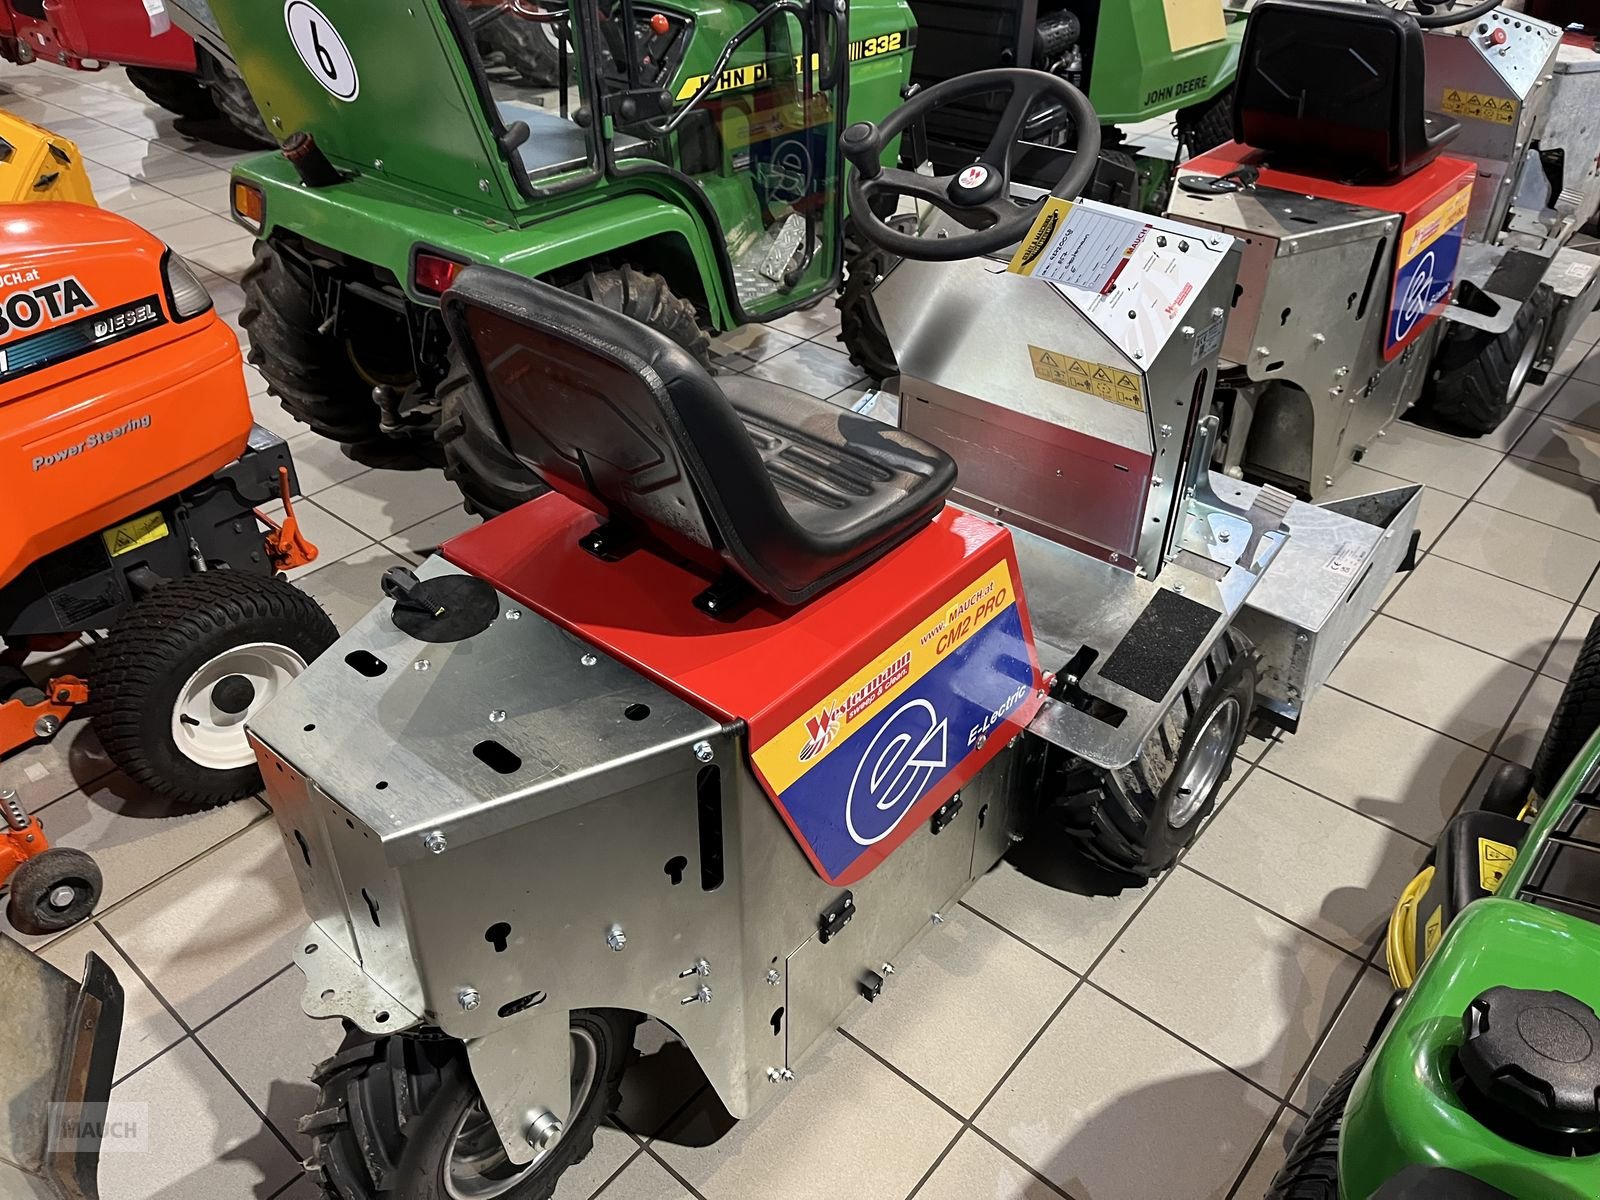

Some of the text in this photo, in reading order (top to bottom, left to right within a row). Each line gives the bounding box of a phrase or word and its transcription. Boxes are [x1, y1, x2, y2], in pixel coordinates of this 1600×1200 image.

[309, 19, 338, 81] 6
[864, 32, 901, 57] 332
[1144, 75, 1208, 106] JOHN DEERE
[1126, 228, 1148, 256] MAUCH
[94, 303, 157, 337] DIESEL
[32, 414, 152, 472] Power Steering
[935, 587, 1007, 656] CM2 PRO
[804, 650, 912, 742] Westermann
[848, 692, 876, 718] sweep
[967, 684, 1027, 747] E-Lectric
